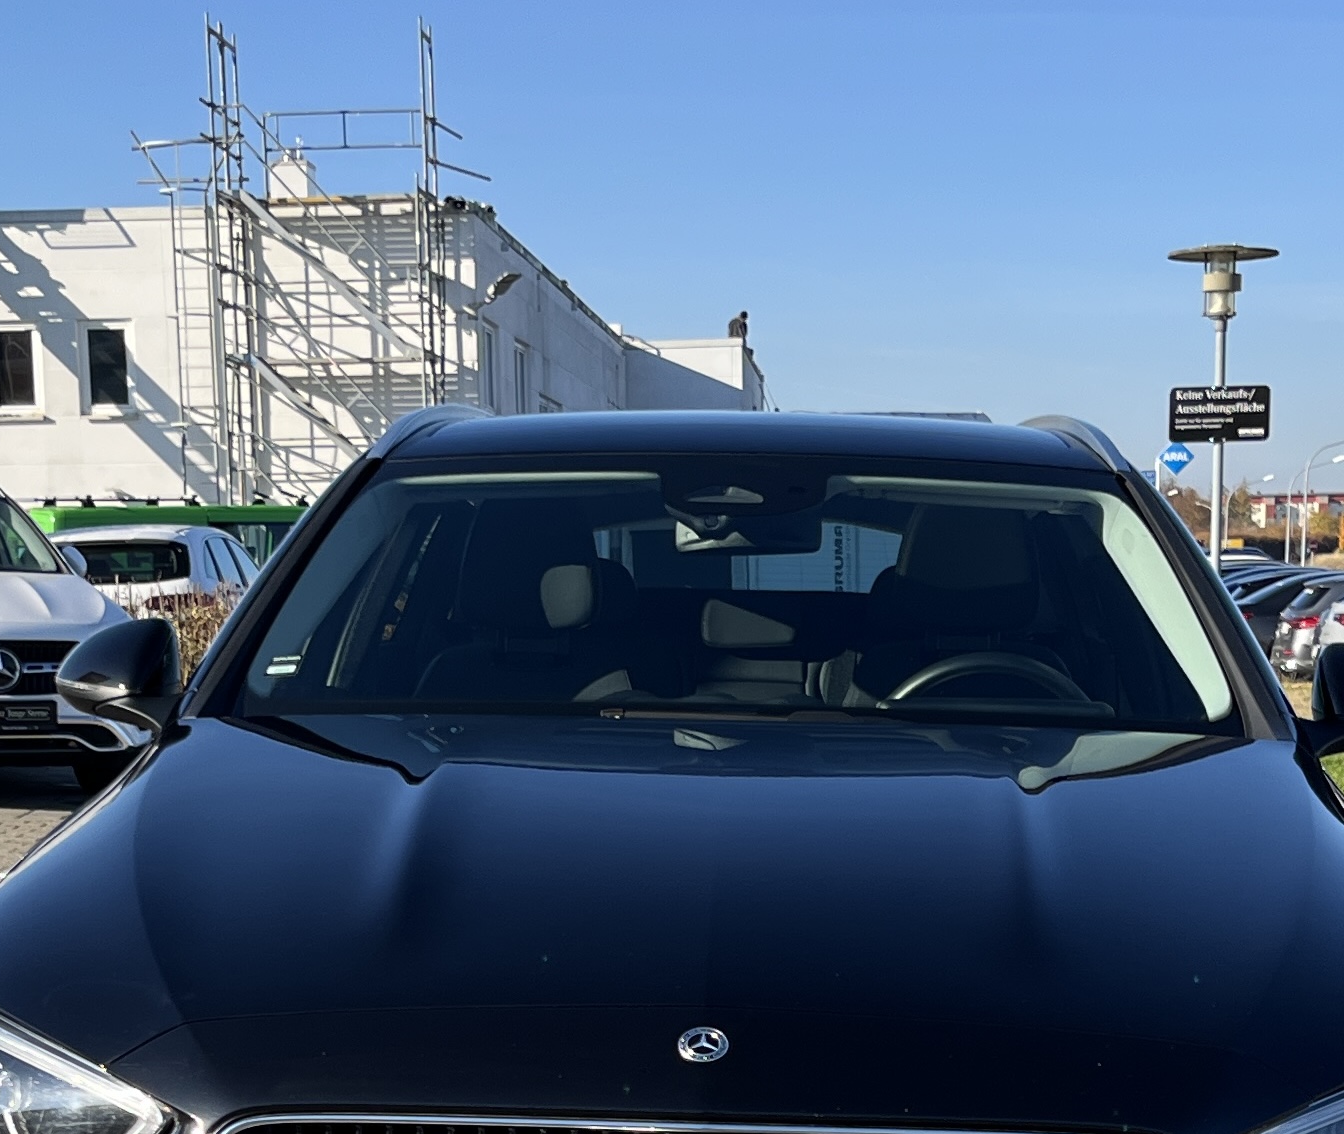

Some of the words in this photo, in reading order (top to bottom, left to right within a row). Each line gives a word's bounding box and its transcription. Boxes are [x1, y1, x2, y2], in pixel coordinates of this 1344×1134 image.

[1175, 390, 1203, 400] Keine
[1175, 402, 1265, 415] Ausstellungsfläche
[1163, 452, 1189, 462] ARAL
